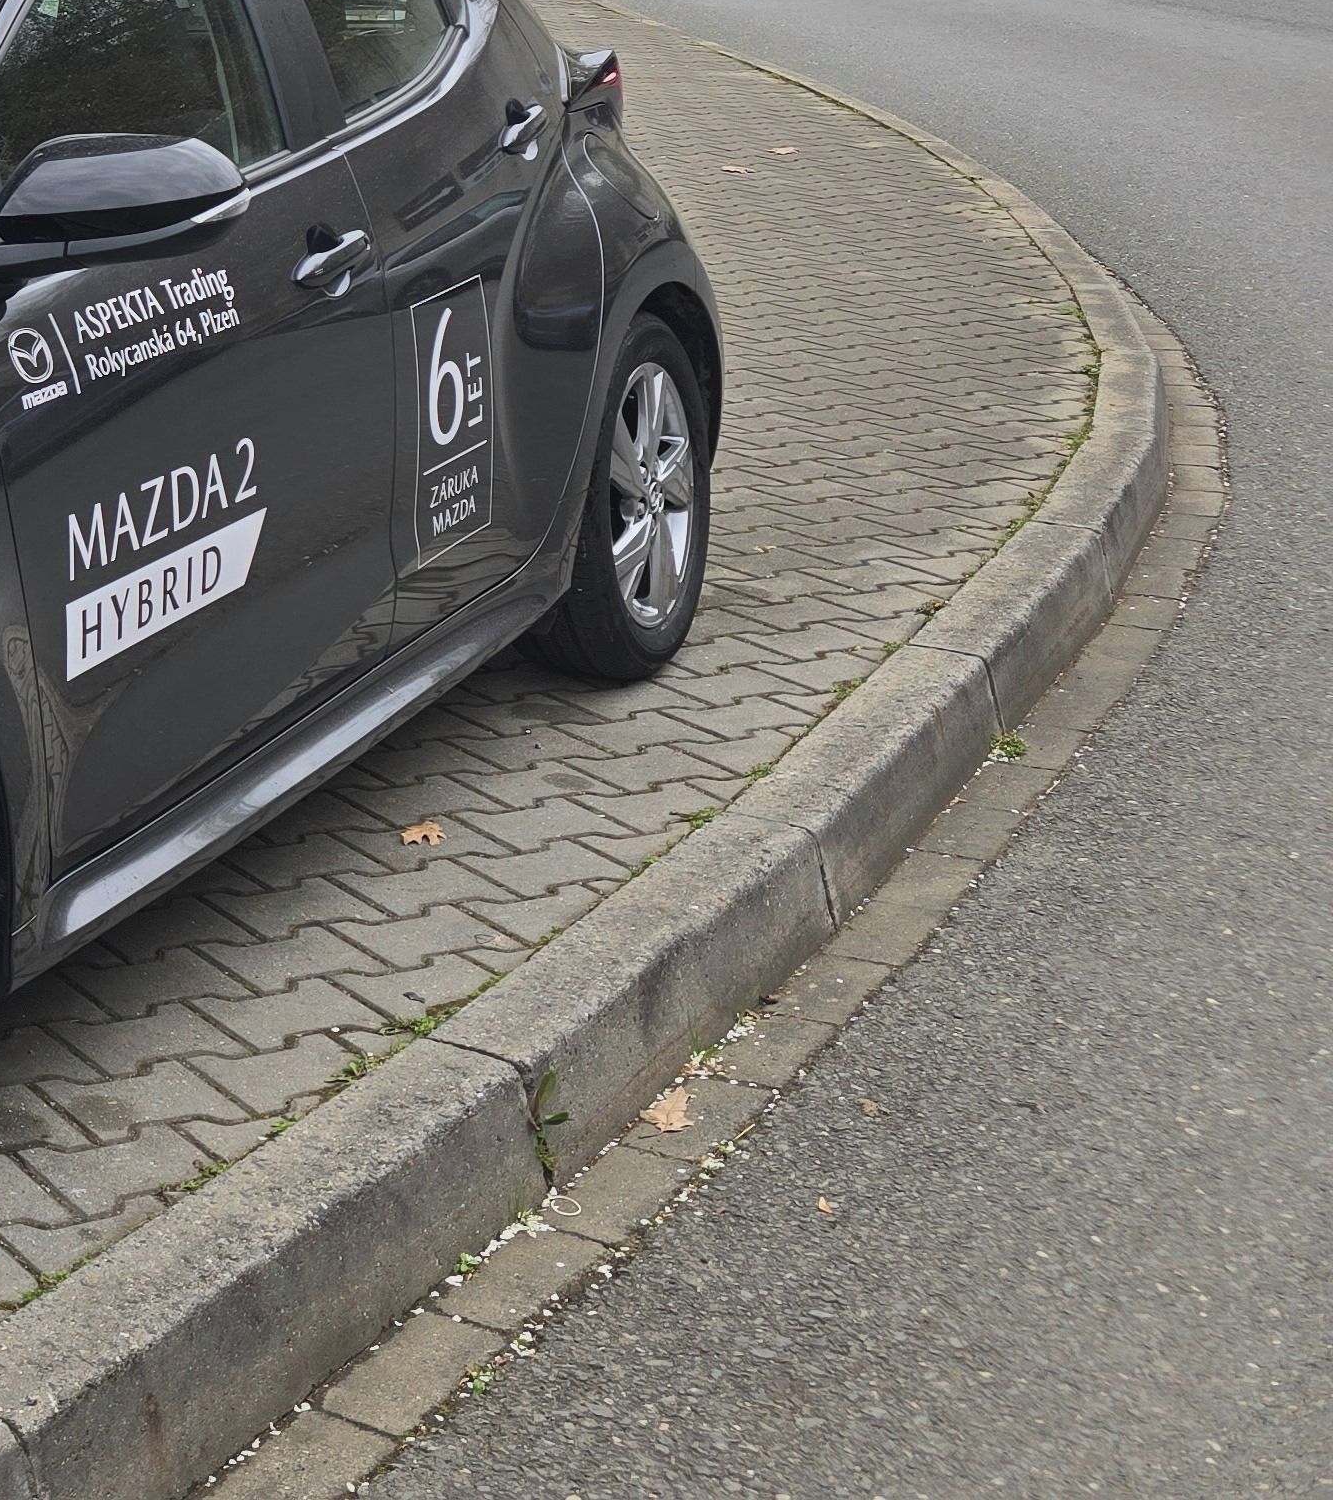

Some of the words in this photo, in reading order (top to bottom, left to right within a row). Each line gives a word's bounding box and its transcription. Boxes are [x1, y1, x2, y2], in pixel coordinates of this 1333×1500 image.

[73, 286, 165, 344] ASPEKTA
[159, 267, 235, 311] Trading
[84, 324, 176, 381] Rokycanská
[174, 317, 202, 345] 64,
[199, 301, 241, 338] Plzeň
[21, 380, 68, 410] mazda
[428, 307, 464, 446] 6
[465, 352, 483, 428] LET
[68, 453, 228, 582] MAZDA
[234, 436, 258, 503] 2
[429, 464, 479, 509] ZÁRUKA
[432, 494, 476, 537] MAZDA
[80, 545, 222, 660] HYBRID
